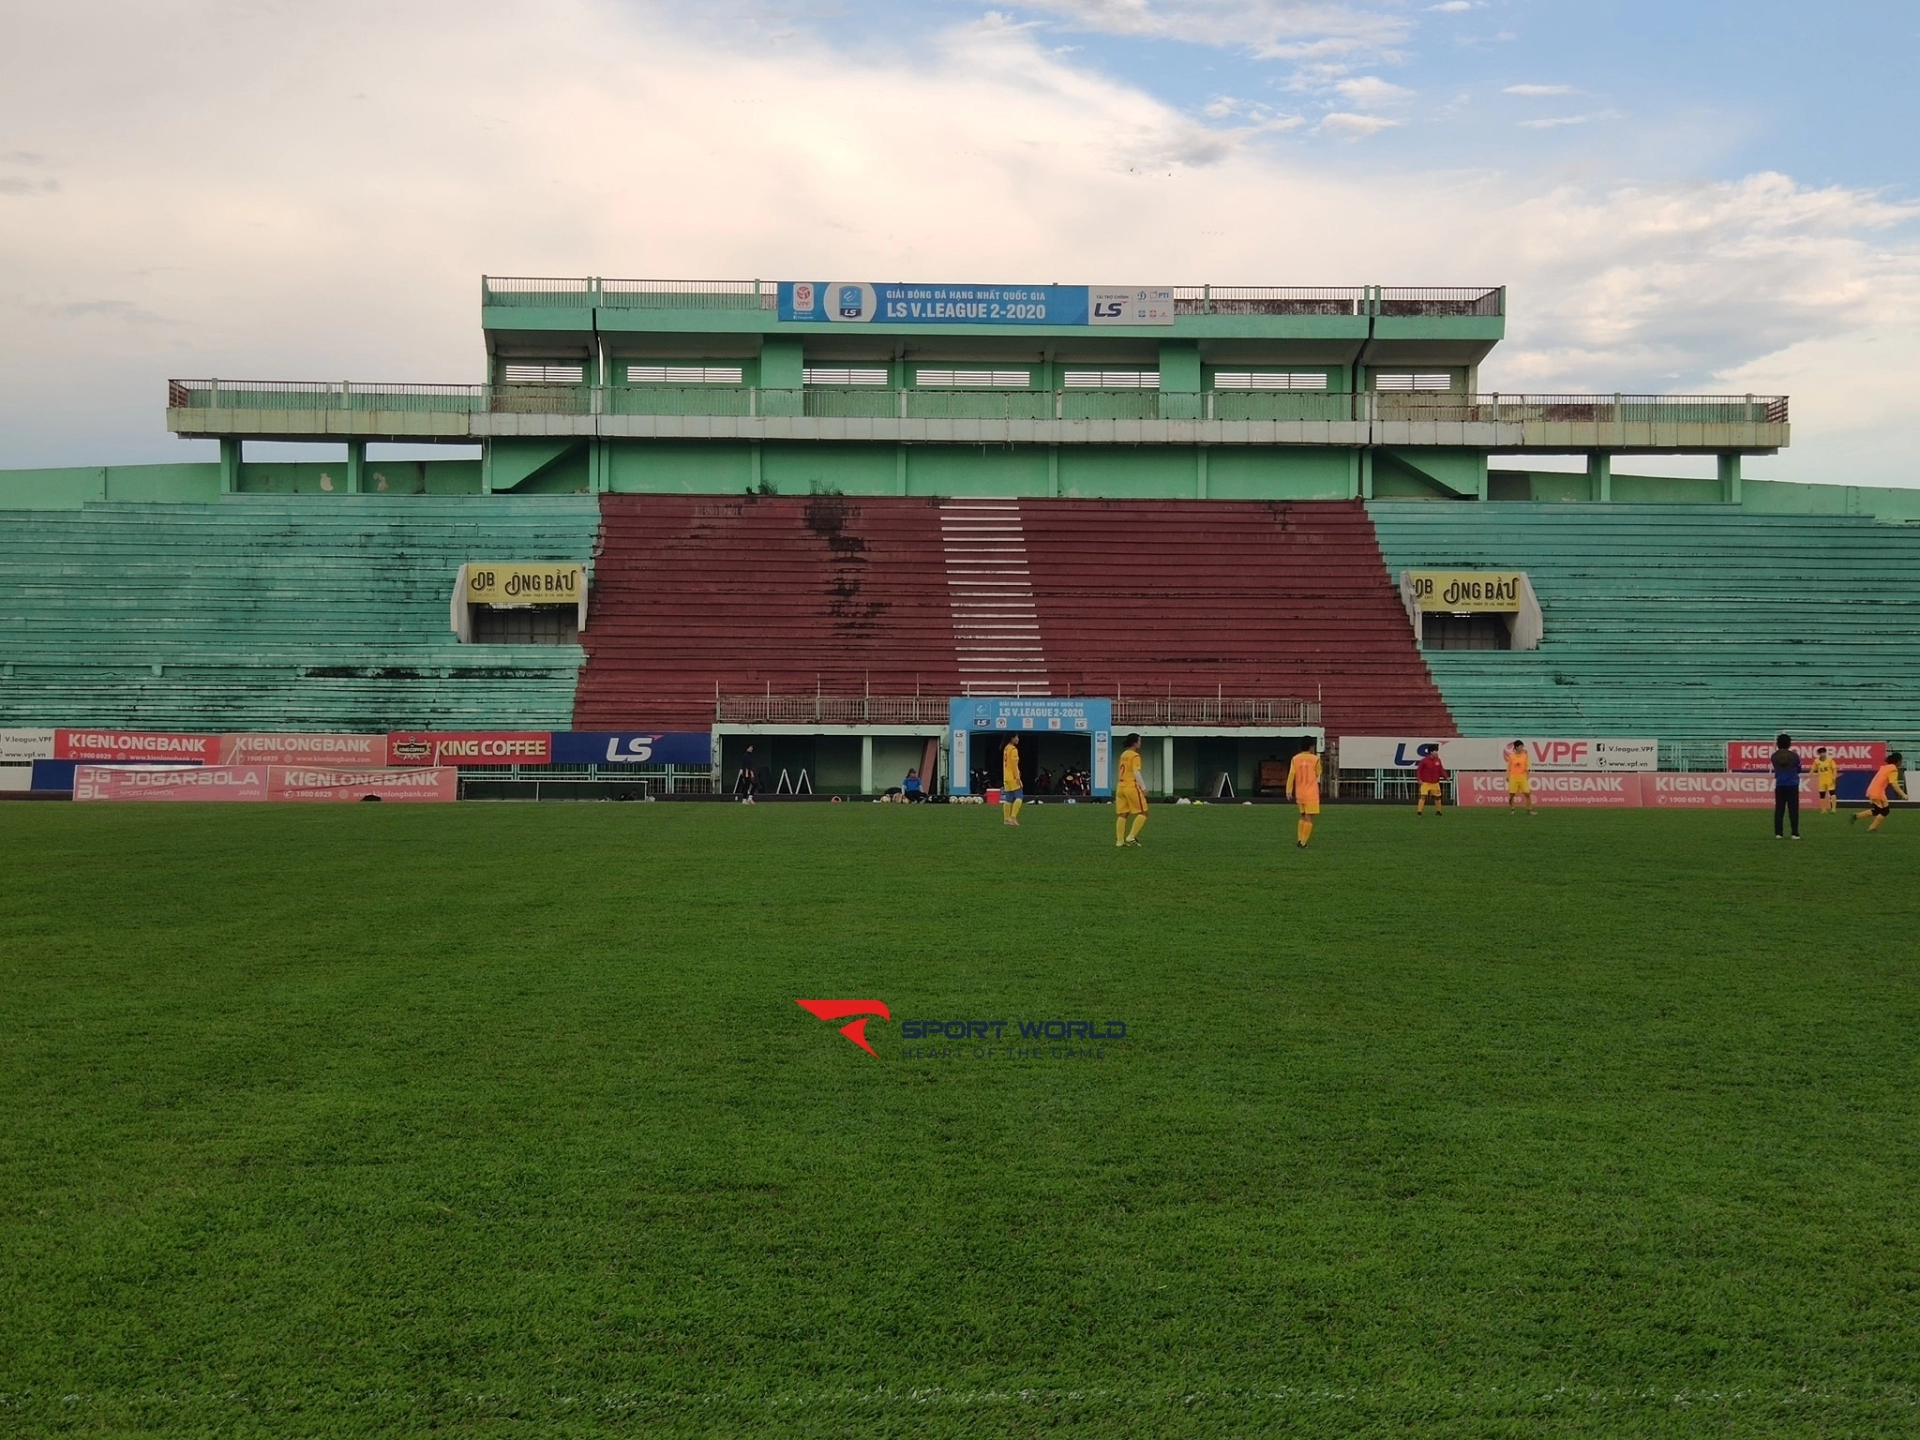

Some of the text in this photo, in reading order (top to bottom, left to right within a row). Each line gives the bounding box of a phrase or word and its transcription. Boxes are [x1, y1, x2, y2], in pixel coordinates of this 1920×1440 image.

[886, 288, 1046, 301] GIẢI BÓNG ĐÁ HẠNG NHẤT QUỐC GIA
[887, 302, 1046, 319] LS V.LEAGUE 2-2020
[1094, 303, 1122, 317] LS
[471, 572, 495, 591] OB
[505, 572, 542, 596] ÔNG
[1443, 579, 1481, 604] ÔNG
[1000, 707, 1084, 717] LS V.LEAGUE 2-2020
[68, 734, 206, 752] KIENLONGBANK
[236, 737, 371, 752] KIENLONGBANK
[437, 740, 546, 756] KING COFFEE
[606, 737, 653, 762] LS
[1532, 741, 1588, 763] VPF
[80, 769, 111, 783] JG
[120, 771, 260, 786] JOGARBOLA
[284, 771, 439, 786] KIENLONGBANK
[1473, 777, 1623, 791] KIEONGBANK
[1655, 777, 1811, 792] KIENLONGBK
[77, 785, 109, 799] BL
[1541, 796, 1625, 804] www.kienlongbank.com
